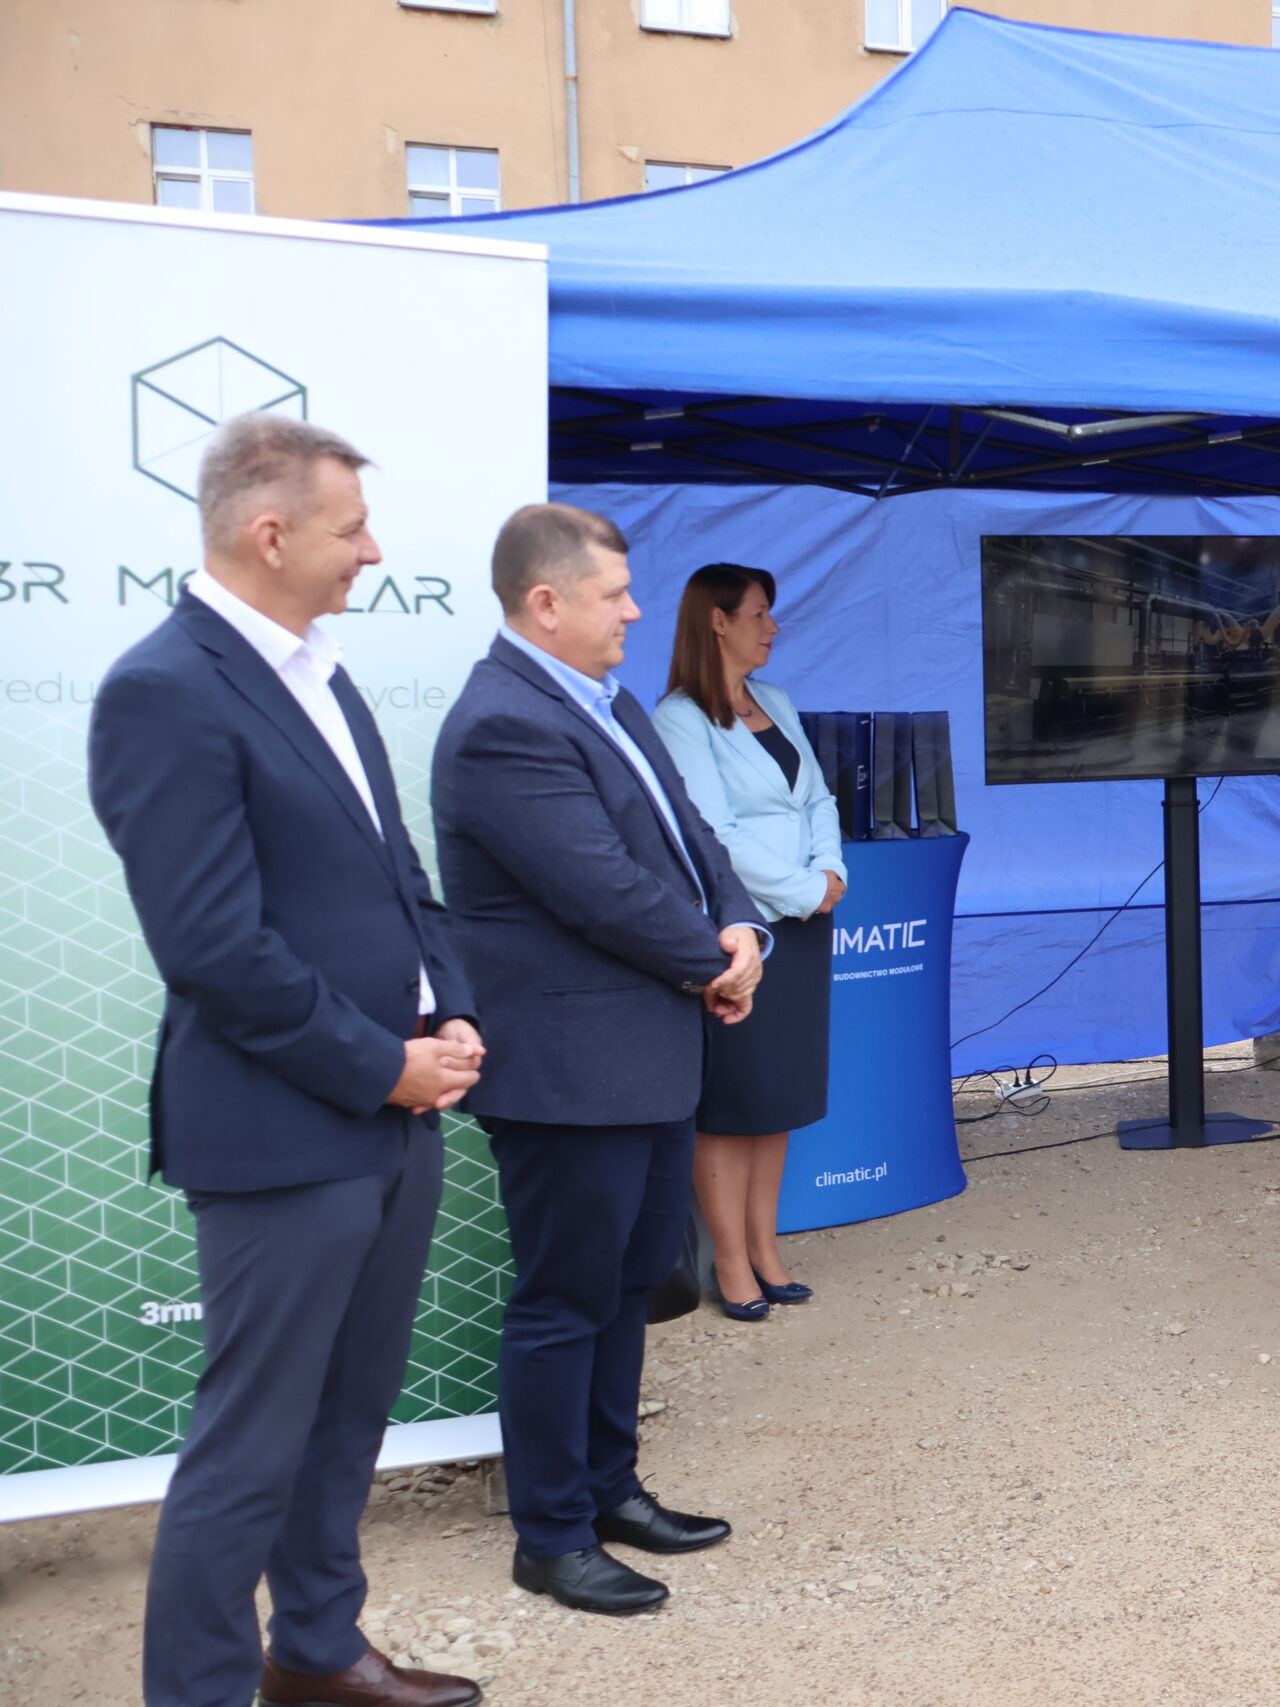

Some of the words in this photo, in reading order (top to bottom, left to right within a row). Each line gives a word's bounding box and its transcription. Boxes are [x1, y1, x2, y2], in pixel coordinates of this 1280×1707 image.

[832, 919, 927, 956] IMATIC
[833, 969, 888, 982] BUDOWNICTWO
[815, 1161, 888, 1188] climatic.pl
[139, 1301, 204, 1326] 3rm
